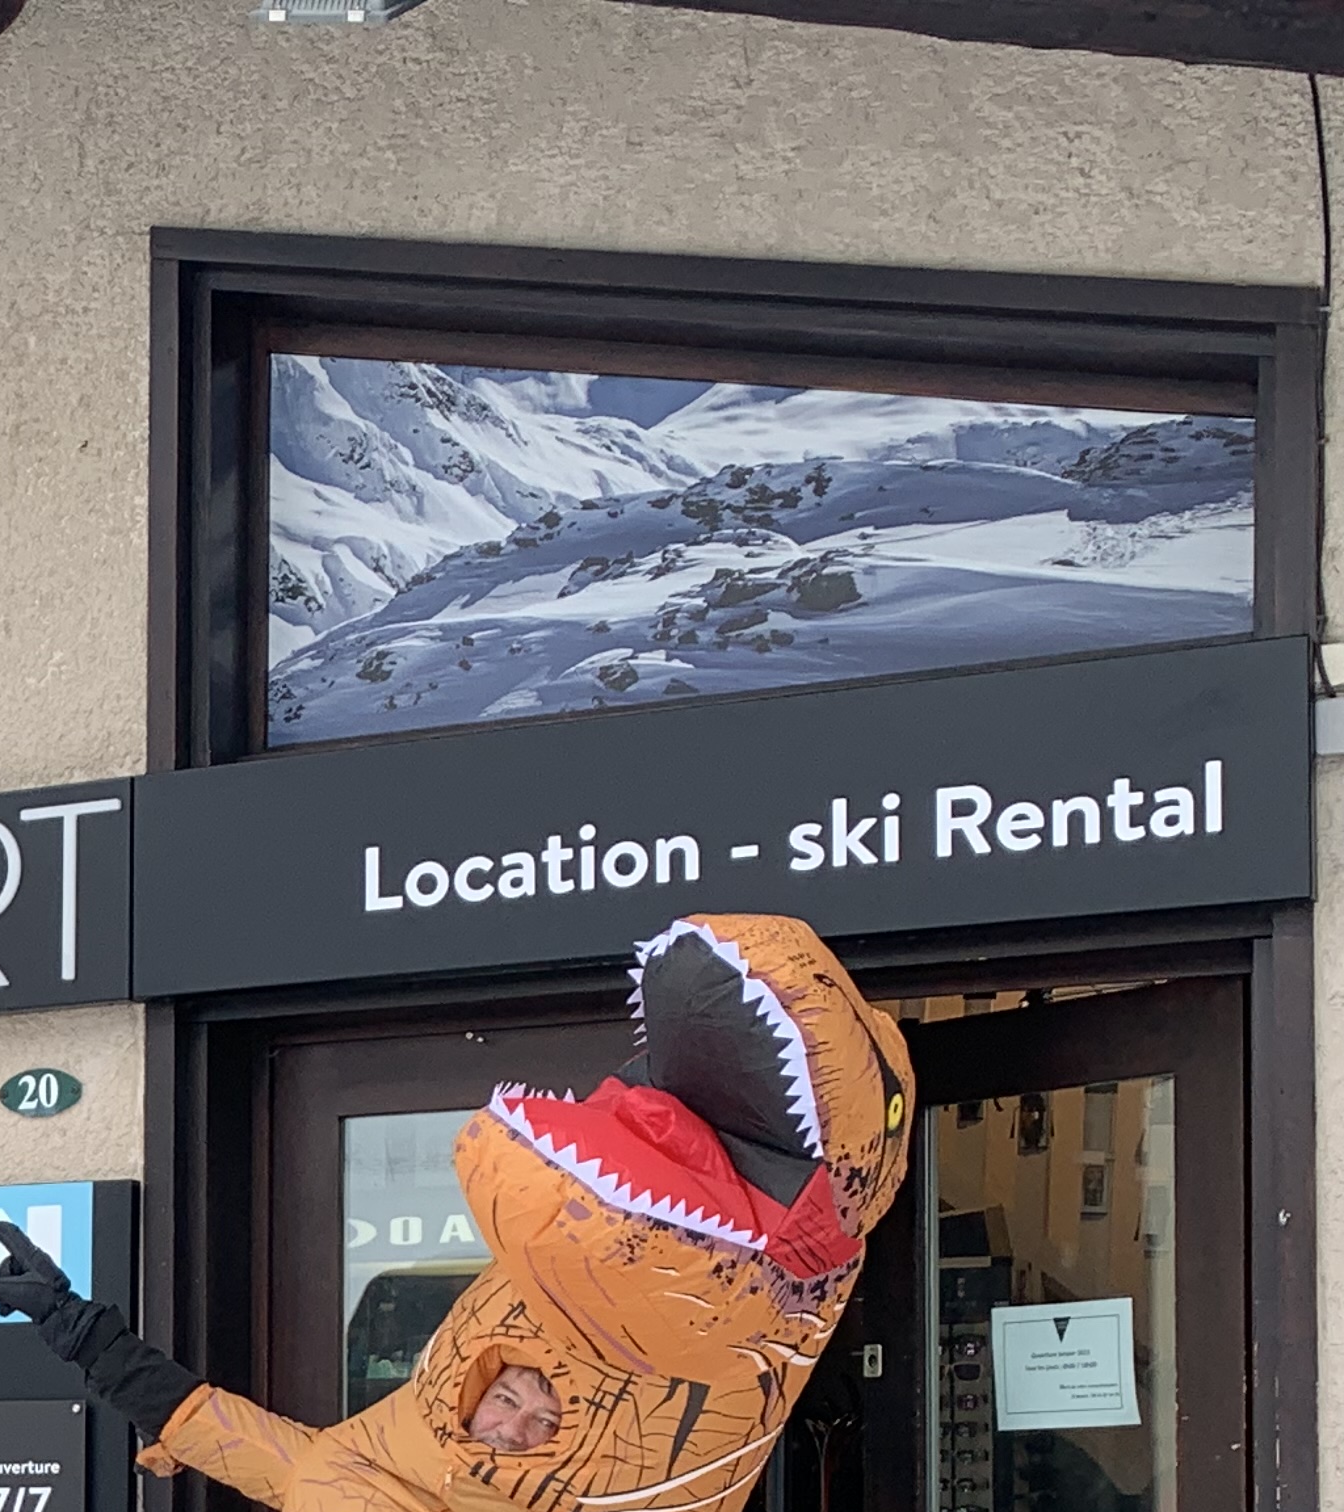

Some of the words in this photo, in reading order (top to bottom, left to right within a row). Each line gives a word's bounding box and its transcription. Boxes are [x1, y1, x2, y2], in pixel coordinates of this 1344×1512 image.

[364, 823, 700, 912] Location
[731, 845, 758, 858] -
[789, 793, 901, 871] ski
[935, 760, 1223, 857] Rental
[17, 1072, 59, 1110] 20
